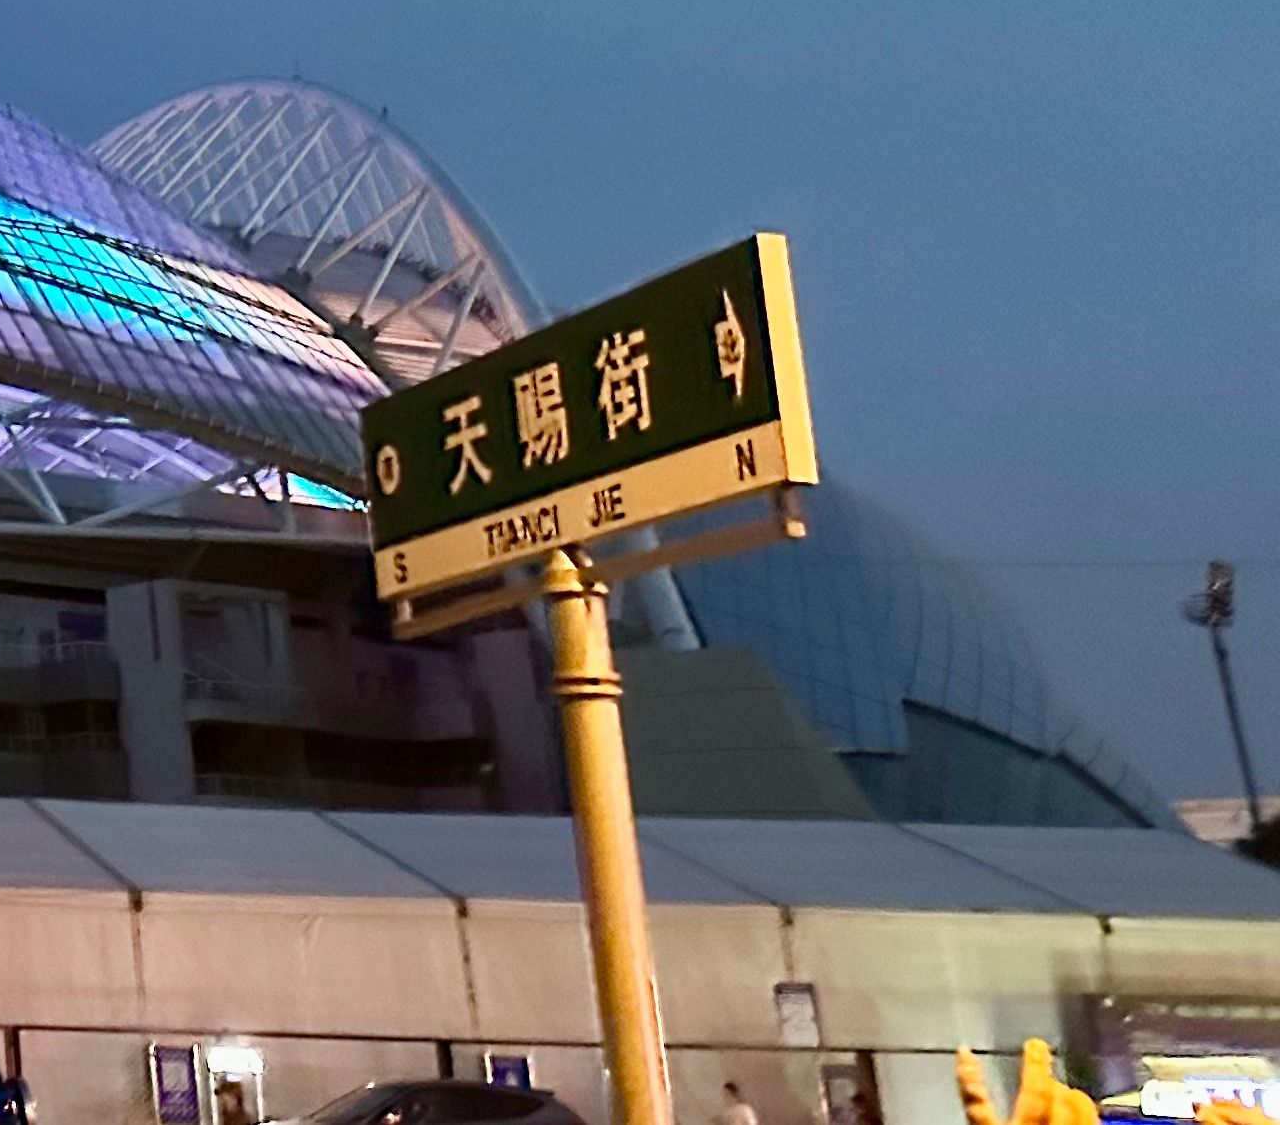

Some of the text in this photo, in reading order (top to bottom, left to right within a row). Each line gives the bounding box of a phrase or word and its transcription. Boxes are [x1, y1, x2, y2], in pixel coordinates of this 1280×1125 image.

[441, 328, 652, 496] 天赐街
[393, 439, 756, 584] S TIANCI JIE N
